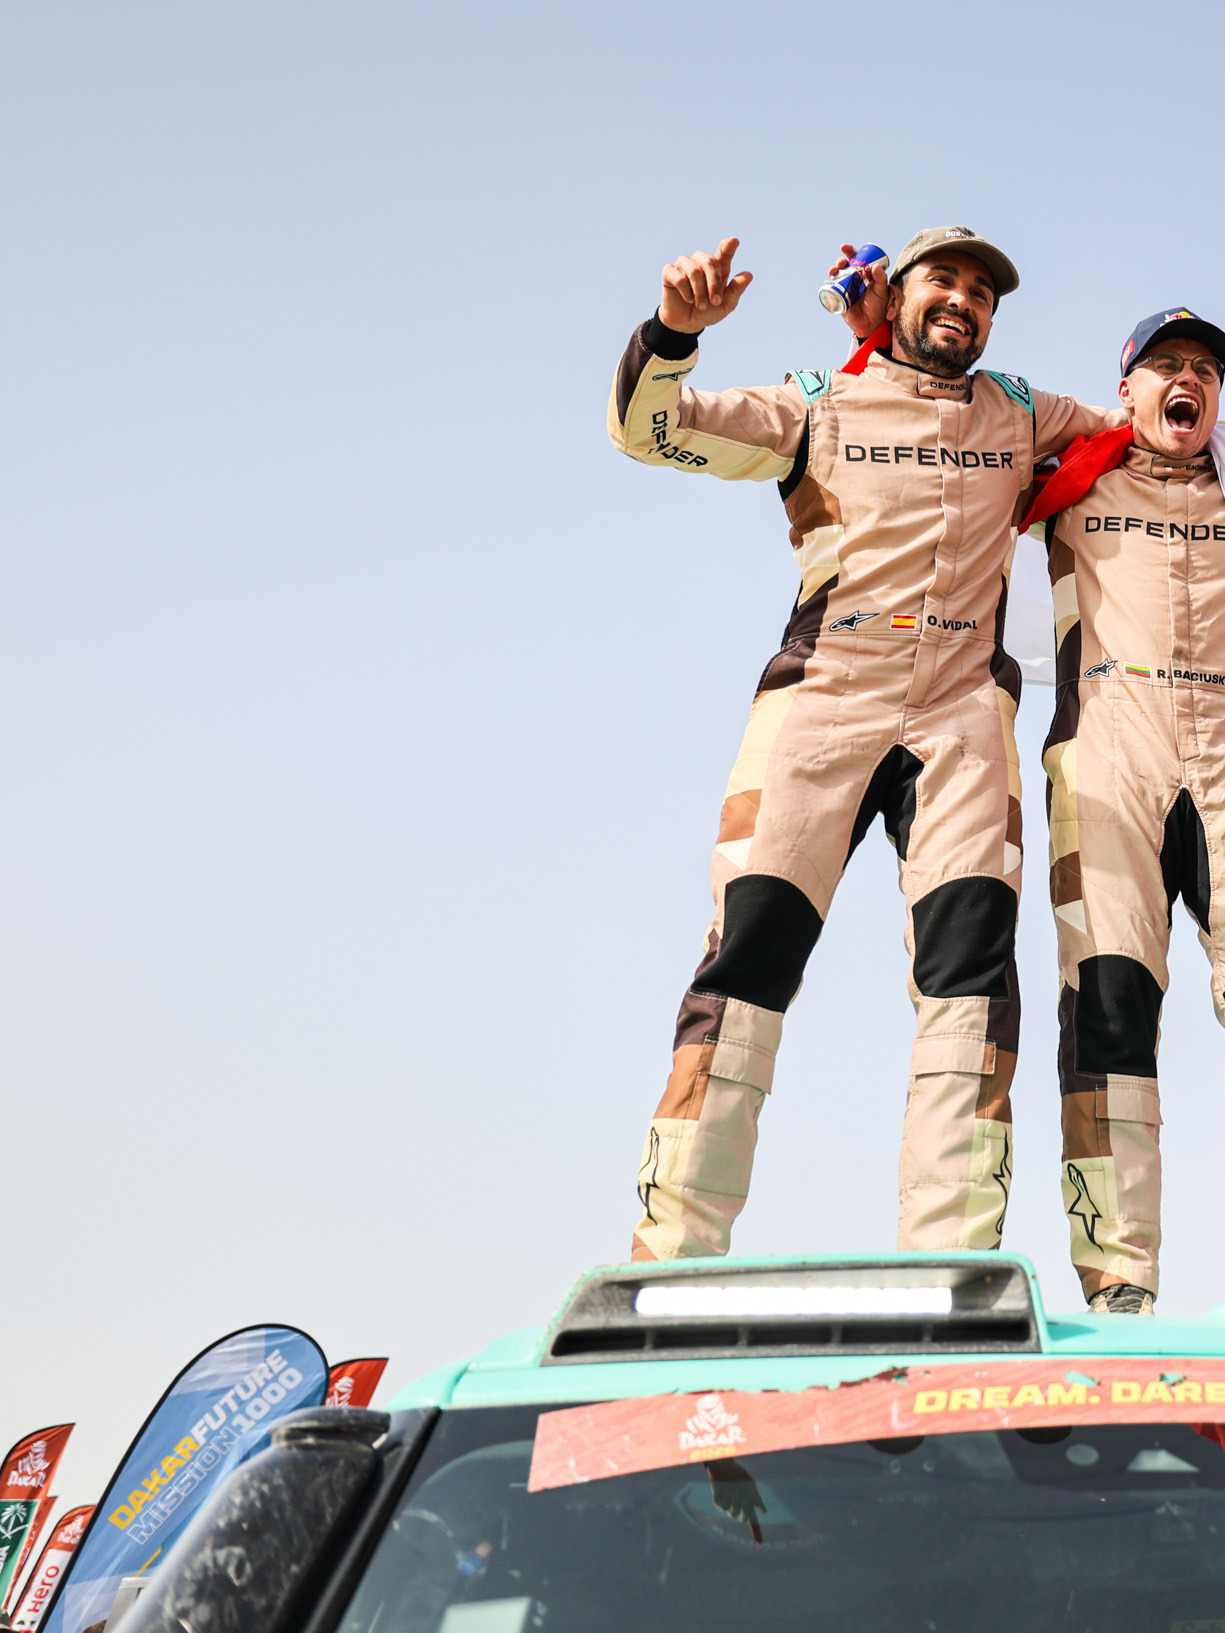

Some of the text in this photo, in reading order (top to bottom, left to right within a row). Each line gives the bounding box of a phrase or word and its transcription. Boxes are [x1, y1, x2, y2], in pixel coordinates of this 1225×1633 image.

[845, 444, 1013, 469] DEFENDER
[913, 1383, 1101, 1414] DREAM.
[27, 1565, 60, 1613] Hero
